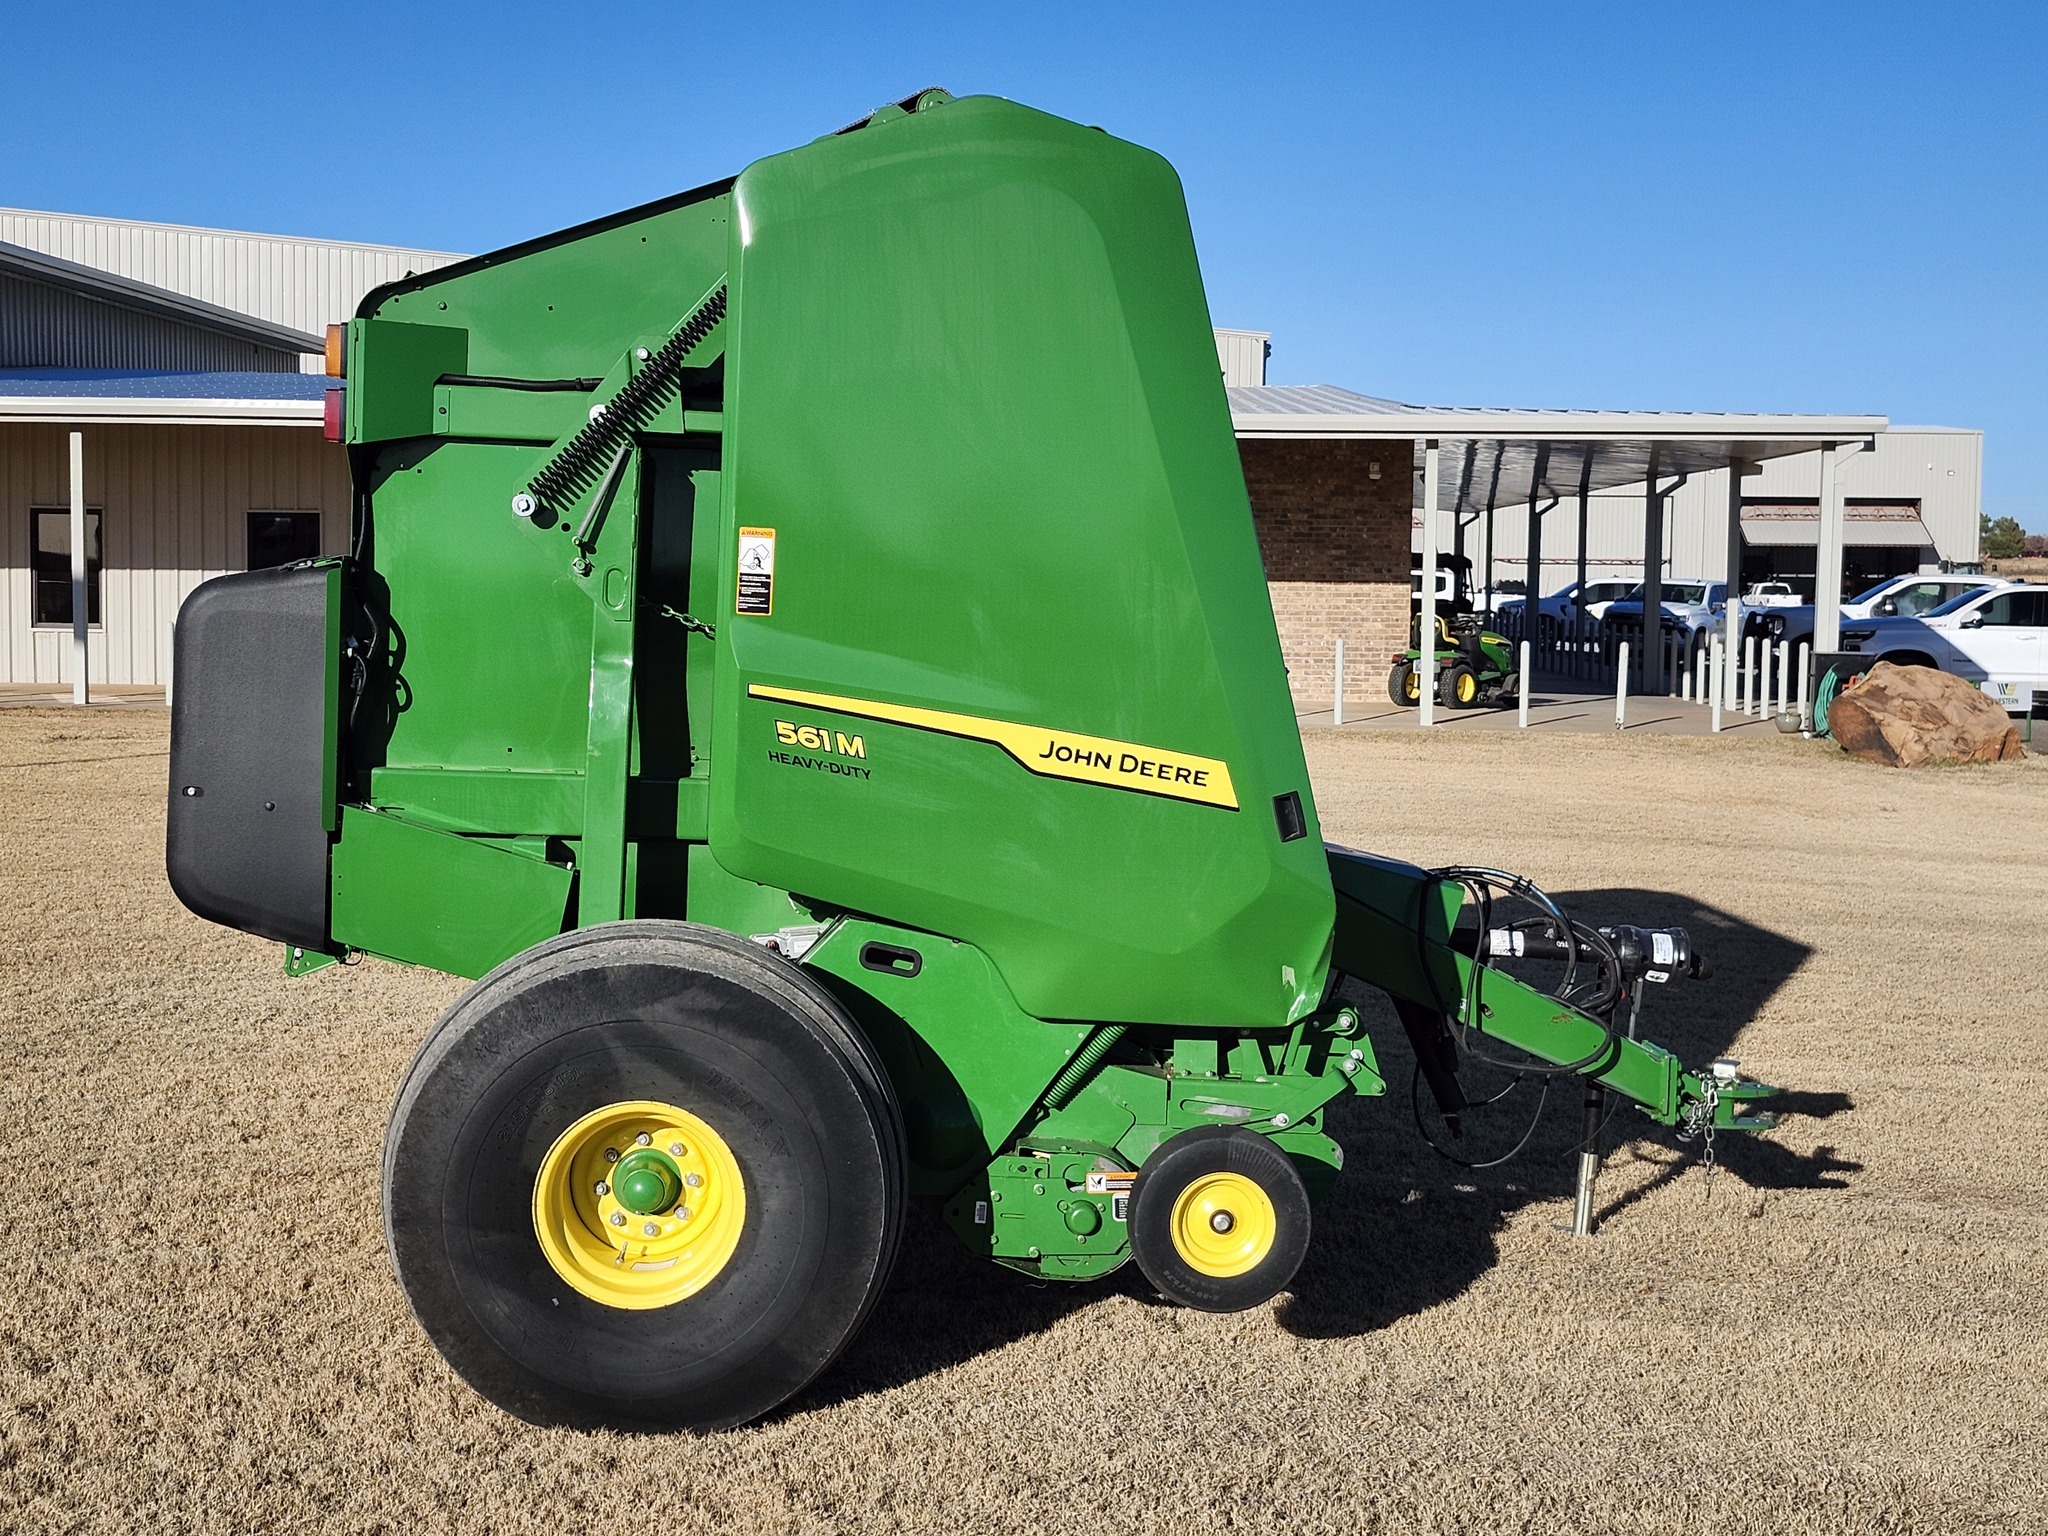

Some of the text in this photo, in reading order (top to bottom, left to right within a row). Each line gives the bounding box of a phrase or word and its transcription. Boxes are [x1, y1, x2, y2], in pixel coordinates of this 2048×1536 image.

[767, 749, 871, 781] HEAVY-DUTY
[1039, 740, 1210, 788] JOHN DEERE
[703, 1068, 792, 1158] TITAN
